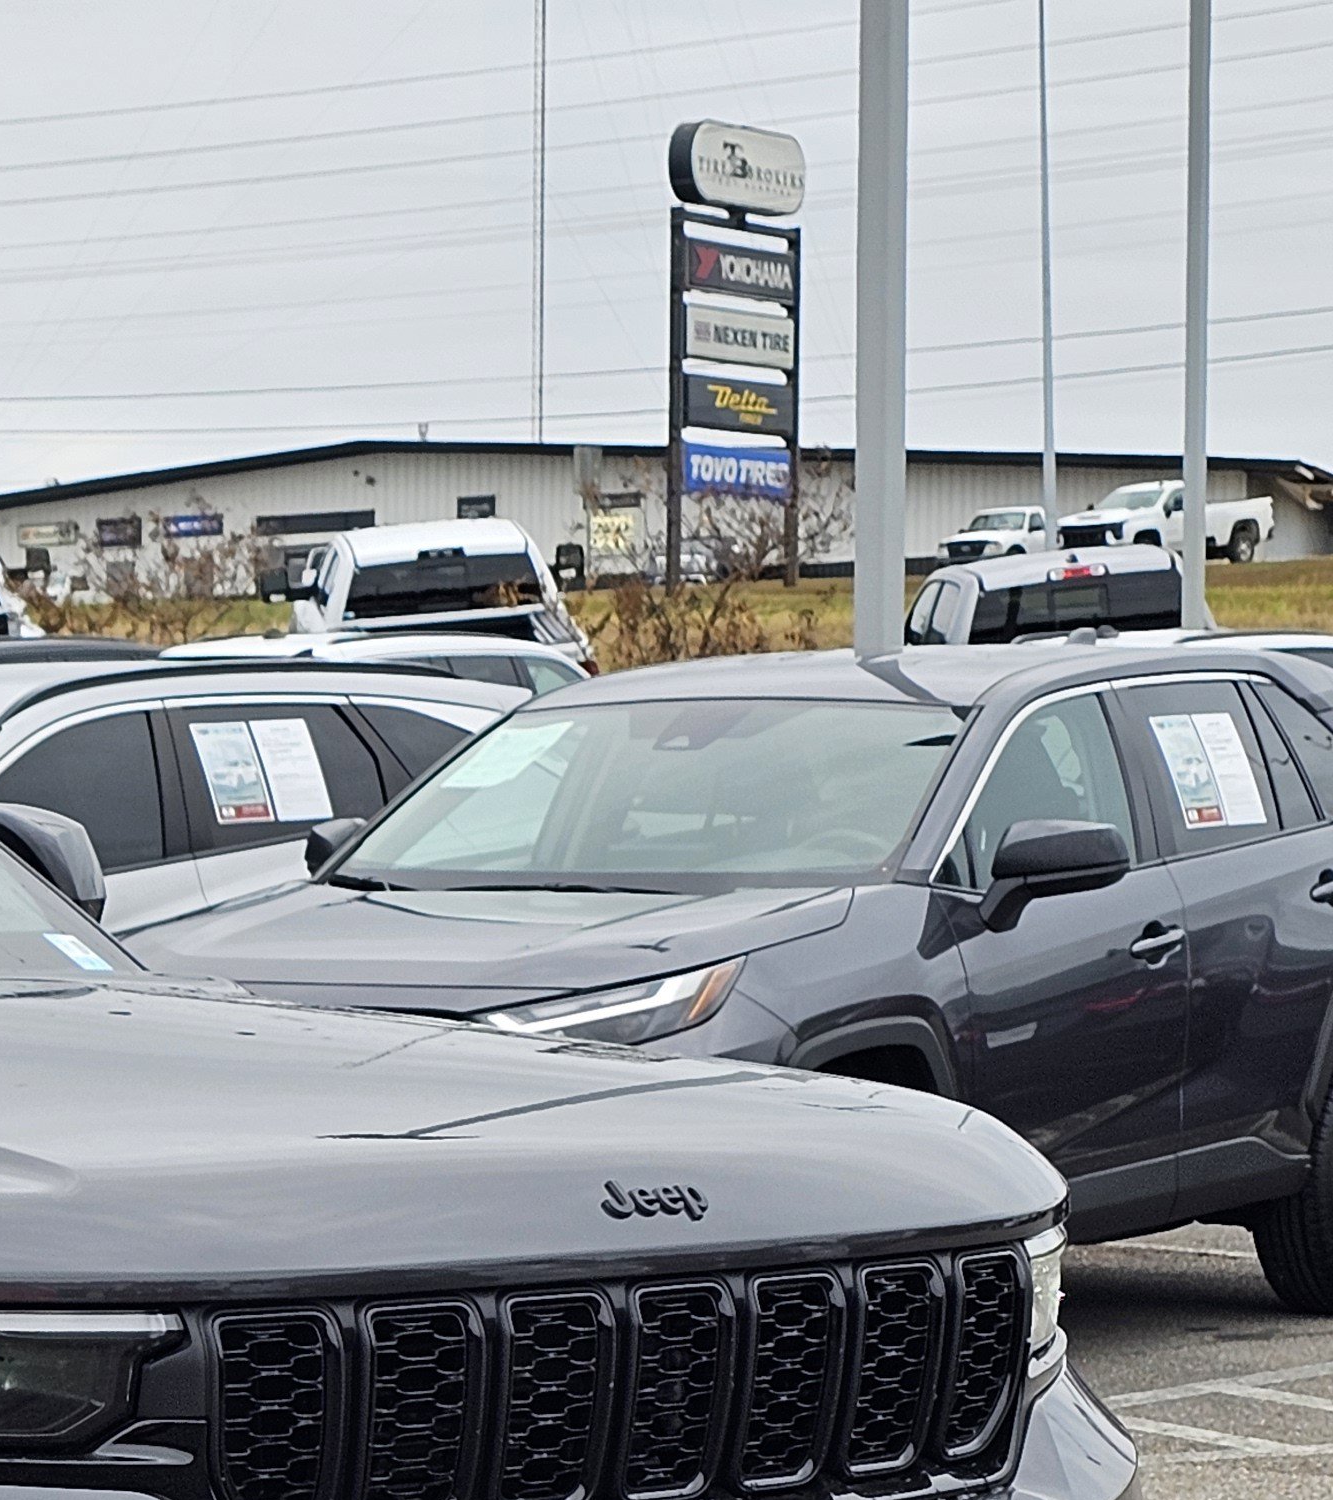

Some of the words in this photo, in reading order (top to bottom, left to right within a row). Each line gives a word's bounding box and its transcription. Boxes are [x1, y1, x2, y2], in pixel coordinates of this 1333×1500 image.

[719, 253, 793, 291] YOKOHAMA
[713, 324, 757, 349] NEXEN
[761, 331, 790, 353] TIRE
[707, 384, 777, 415] Delta
[690, 454, 738, 483] TOYO
[600, 1180, 709, 1222] Jeep
